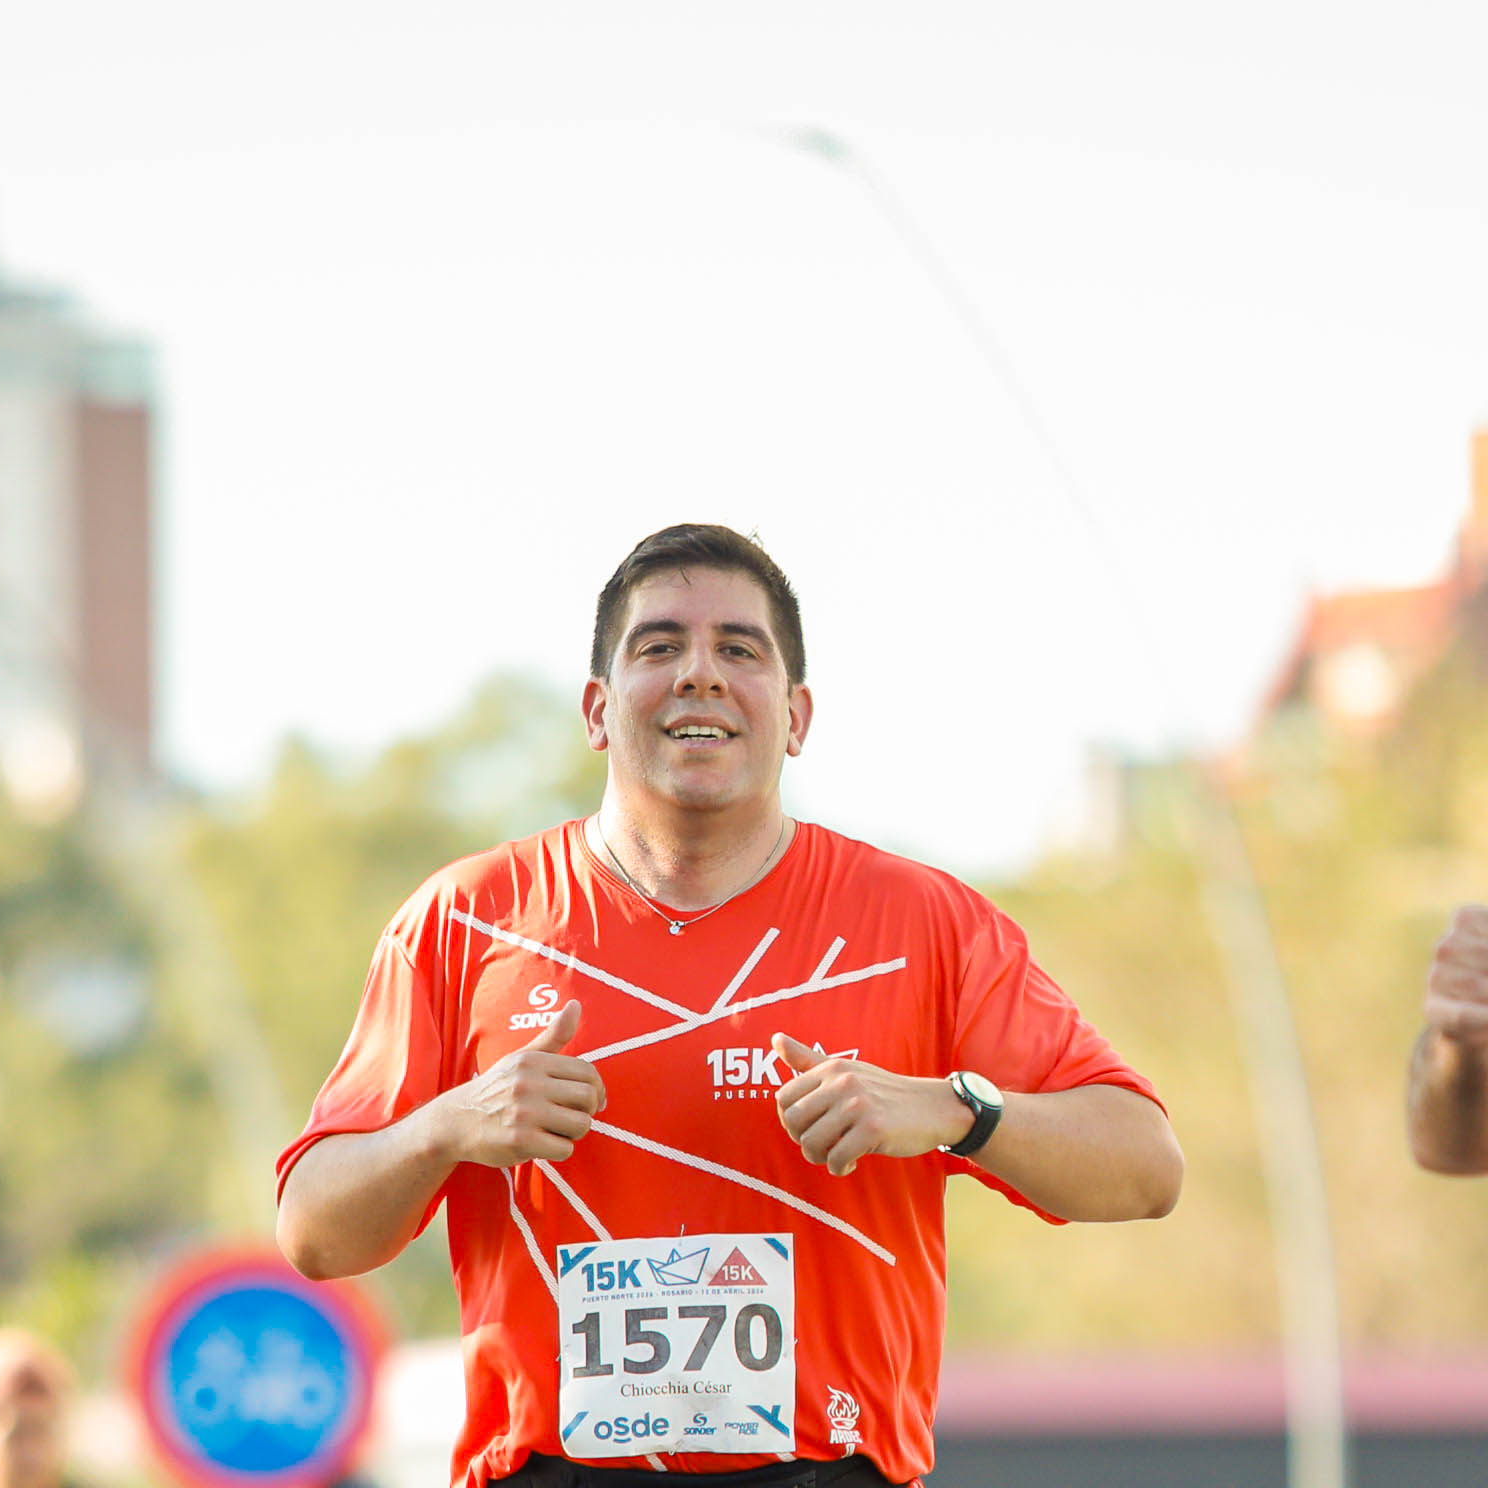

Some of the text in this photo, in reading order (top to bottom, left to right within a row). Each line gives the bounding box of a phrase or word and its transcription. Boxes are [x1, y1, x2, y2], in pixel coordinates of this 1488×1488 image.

[509, 1011, 562, 1030] SOND
[707, 1048, 782, 1087] 15K
[714, 1090, 776, 1100] PUERT
[581, 1259, 642, 1292] 15K
[722, 1265, 754, 1281] 15K
[572, 1303, 783, 1378] 1570
[620, 1380, 733, 1397] Chiocchia César
[594, 1412, 670, 1442] osde
